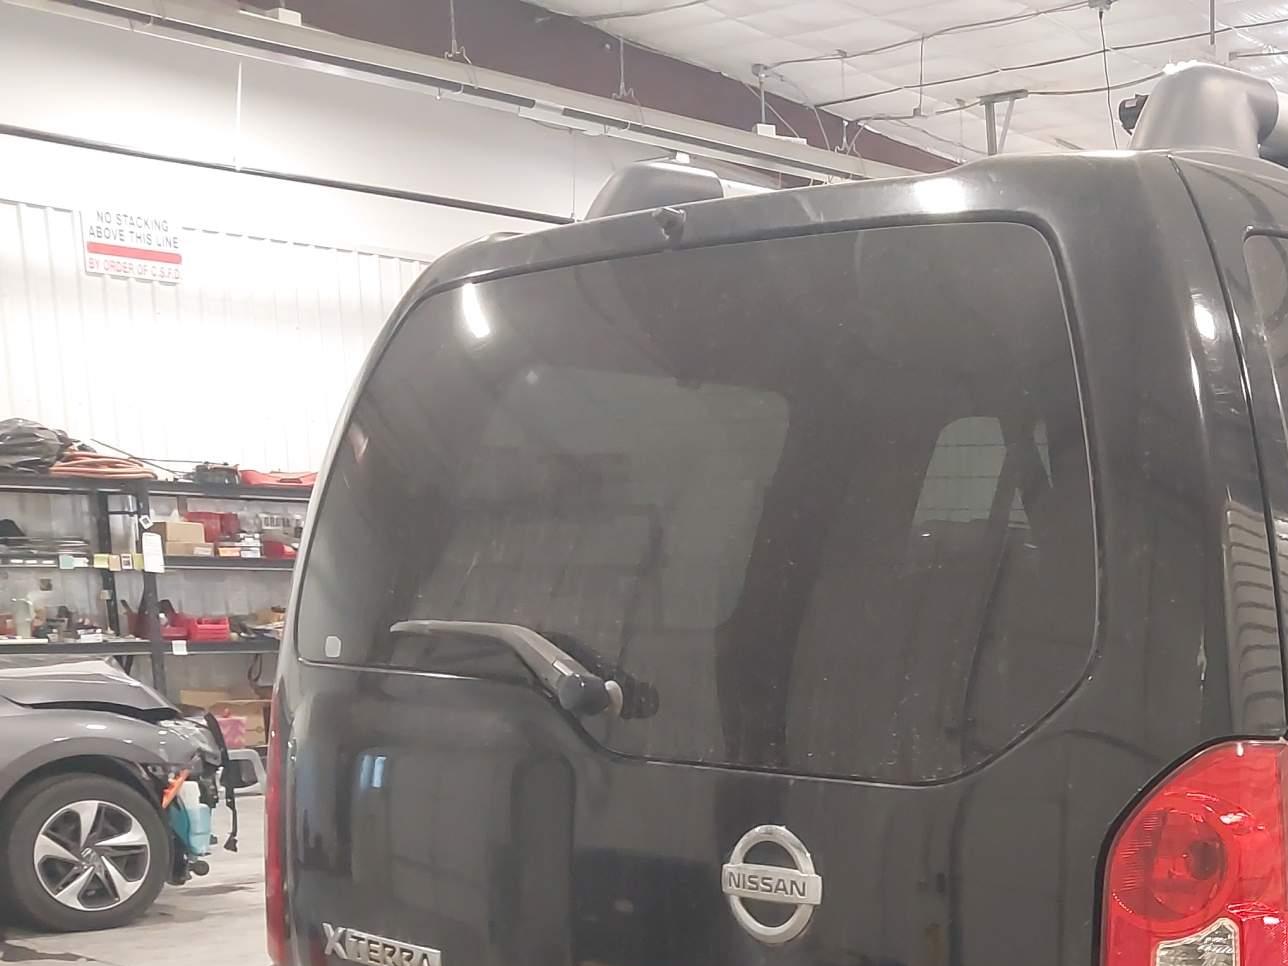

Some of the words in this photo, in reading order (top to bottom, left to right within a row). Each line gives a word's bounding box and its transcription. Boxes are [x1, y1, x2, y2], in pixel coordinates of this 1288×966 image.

[96, 210, 112, 224] NO
[115, 213, 169, 232] STACKING
[88, 225, 125, 242] ABOVE
[129, 230, 153, 246] THIS
[156, 235, 180, 249] LINE
[728, 871, 807, 898] NISSAN
